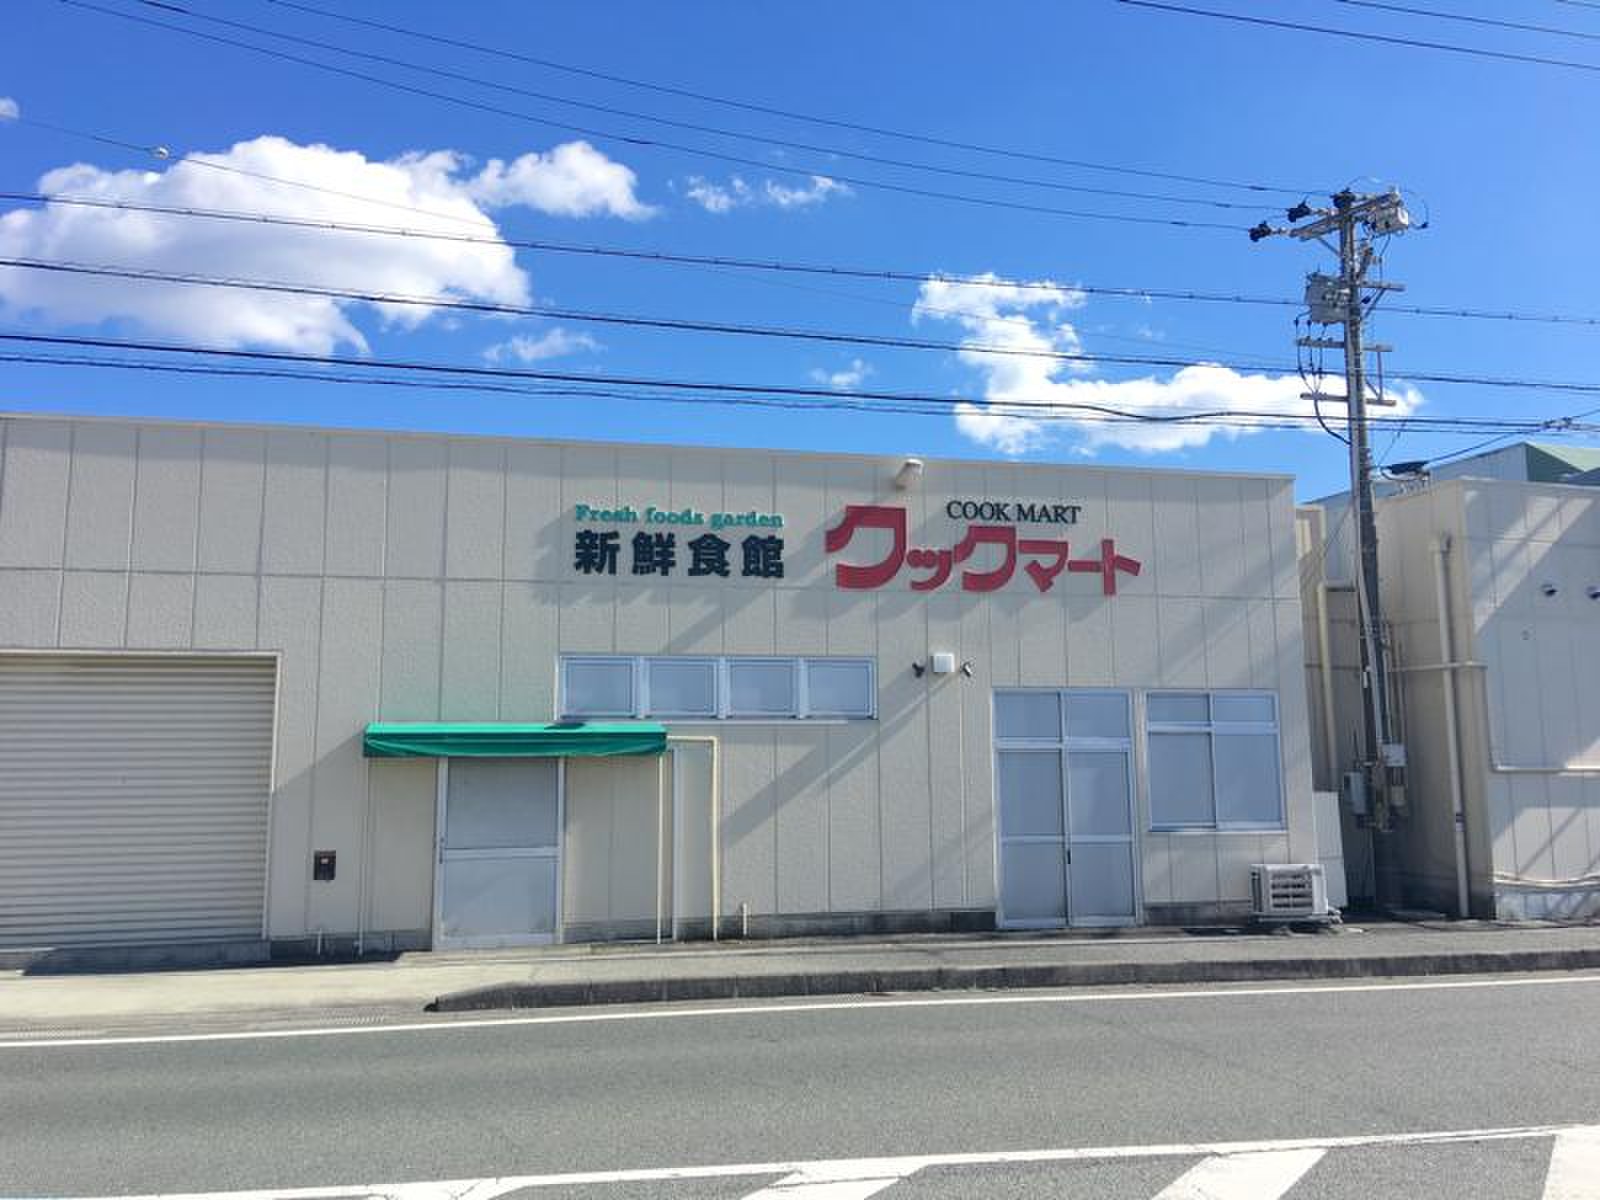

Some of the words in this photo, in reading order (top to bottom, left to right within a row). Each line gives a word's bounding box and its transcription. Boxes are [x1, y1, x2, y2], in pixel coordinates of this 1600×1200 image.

[575, 504, 637, 522] Fresh
[646, 507, 704, 525] foods
[710, 510, 784, 529] garden
[946, 501, 1009, 521] COOK
[1016, 503, 1081, 524] MART
[574, 530, 784, 578] 新鮮食館
[825, 505, 1141, 595] クックマート
